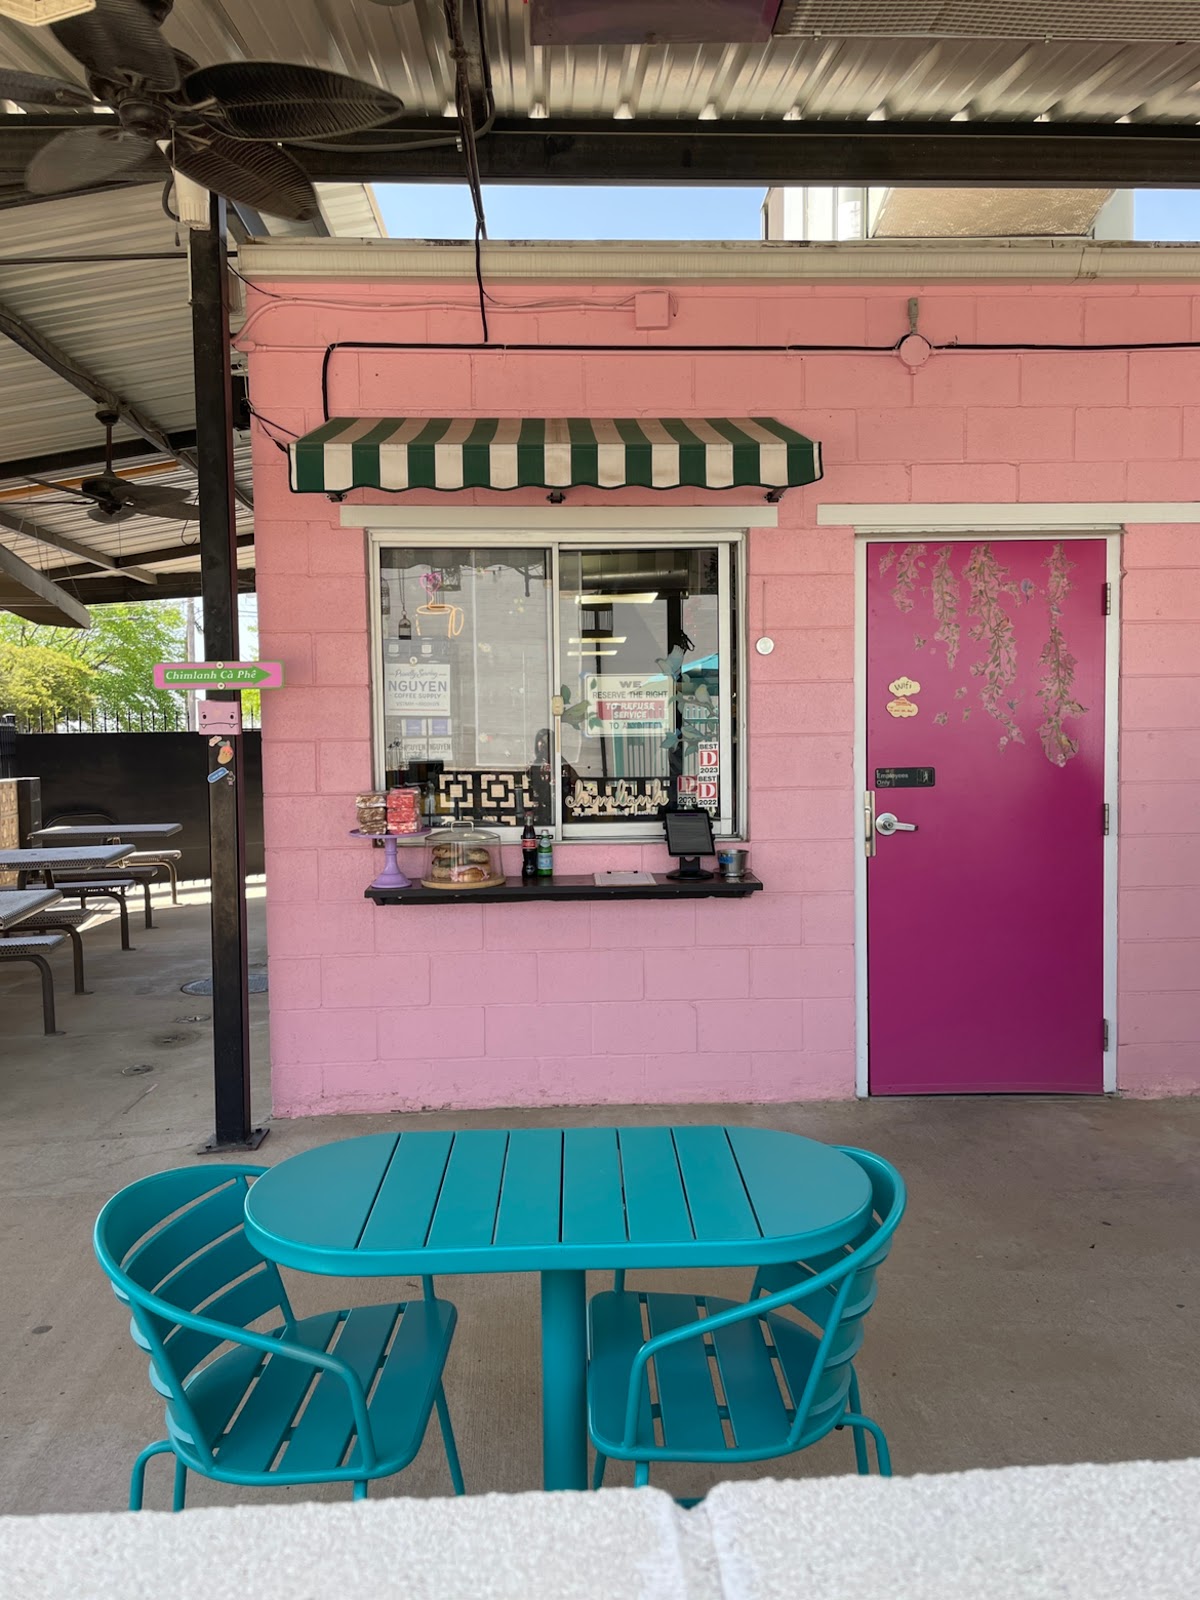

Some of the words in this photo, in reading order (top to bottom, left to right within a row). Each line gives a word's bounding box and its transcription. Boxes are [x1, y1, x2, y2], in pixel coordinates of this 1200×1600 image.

[165, 670, 217, 680] Chimlanh
[220, 670, 234, 679] Cà
[237, 669, 257, 679] Phê
[388, 680, 447, 692] NGUYEN
[619, 680, 642, 689] WE
[592, 691, 626, 699] RESERVE
[629, 690, 643, 698] THE
[645, 690, 668, 698] RIGHT
[620, 702, 655, 711] REFUSE
[613, 711, 647, 719] SERVICE
[701, 751, 717, 766] D
[565, 779, 669, 807] chimlanh
[700, 783, 716, 798] D
